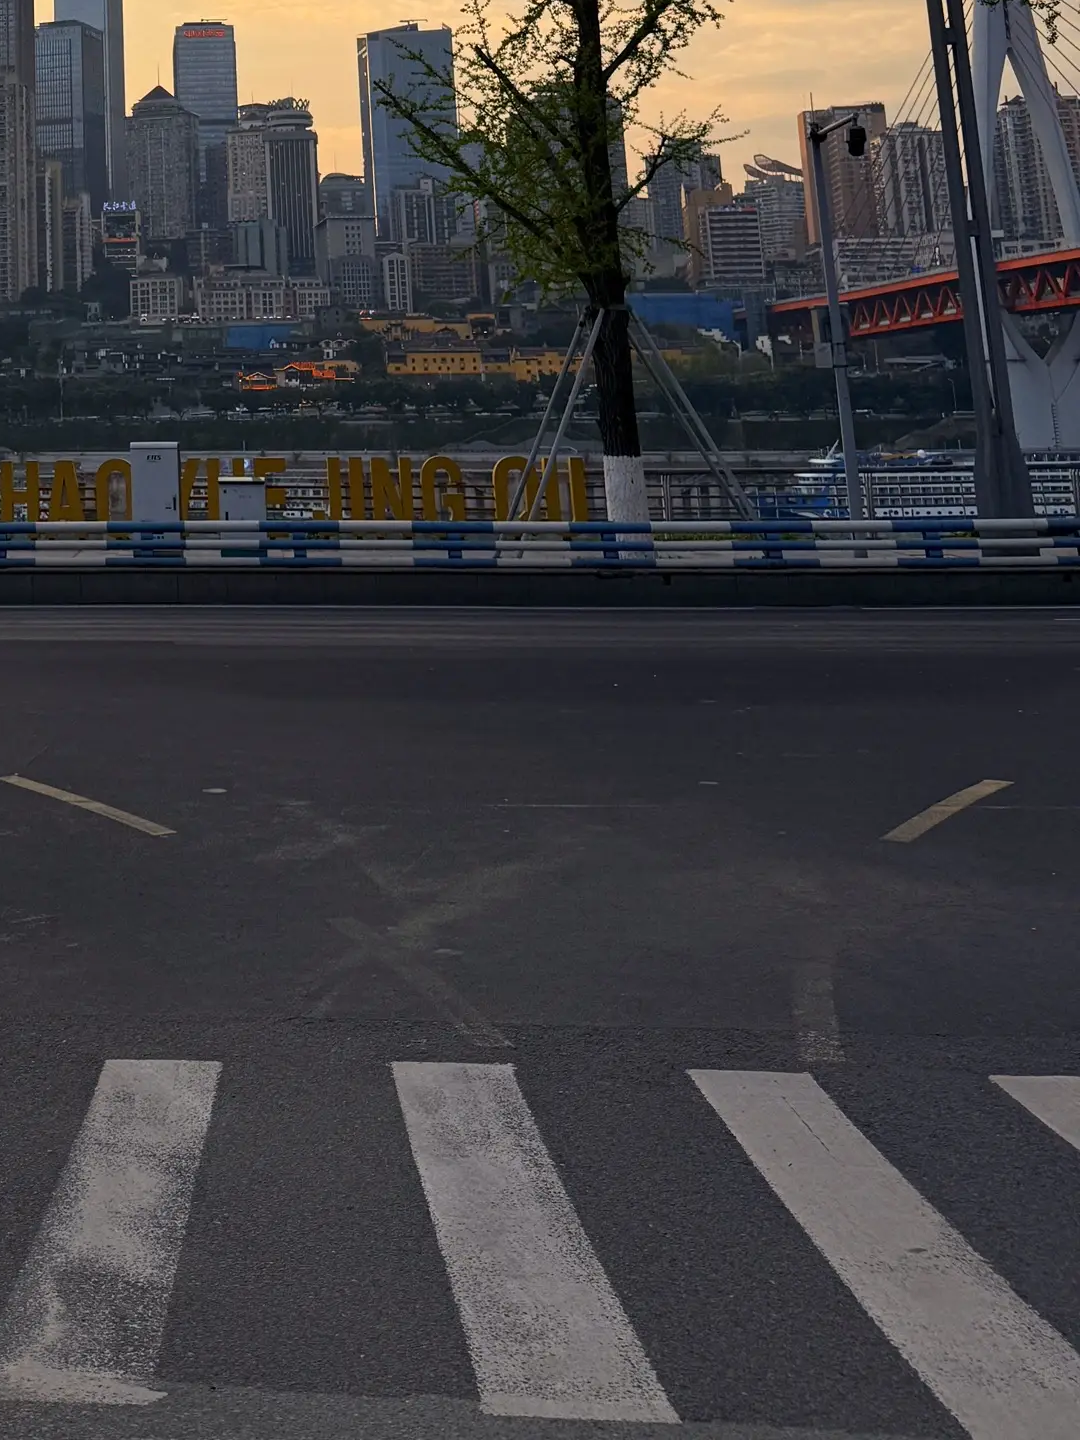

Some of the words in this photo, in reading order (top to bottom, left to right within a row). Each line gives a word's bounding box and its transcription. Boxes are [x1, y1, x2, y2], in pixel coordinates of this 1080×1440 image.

[102, 200, 137, 211] 长江索道
[0, 458, 131, 540] HAO
